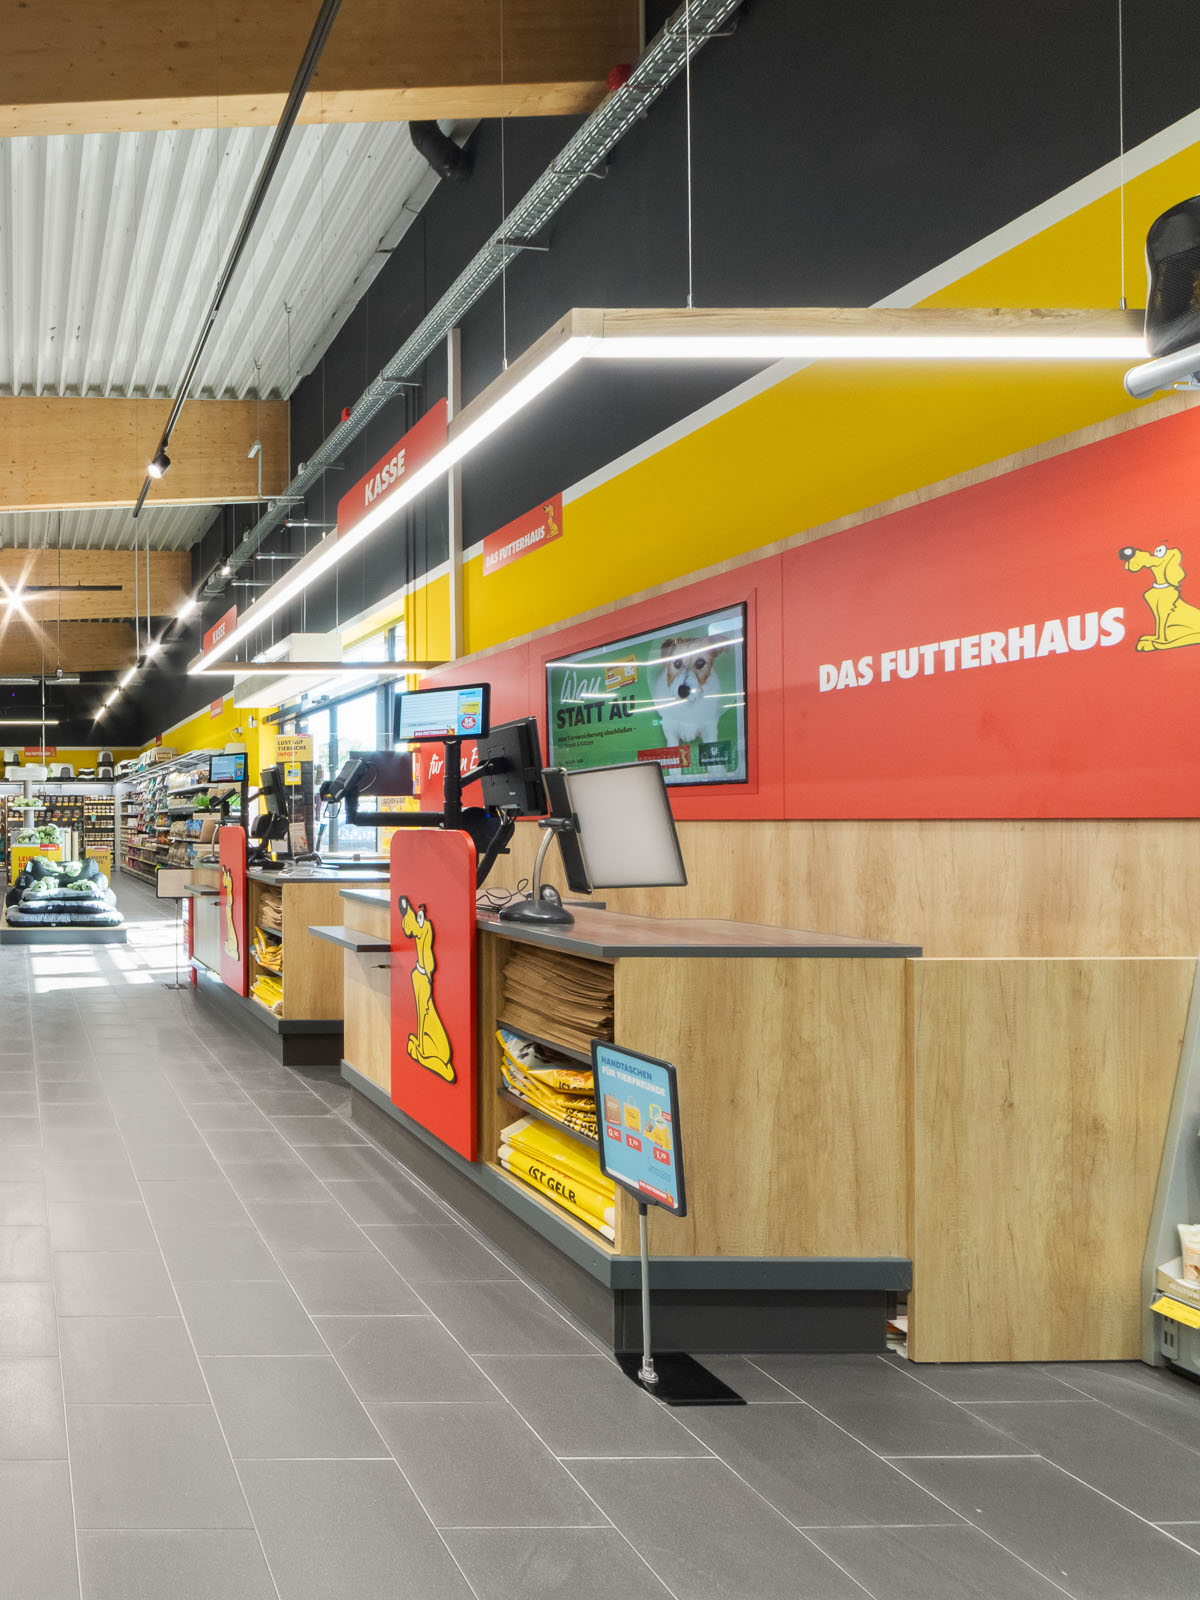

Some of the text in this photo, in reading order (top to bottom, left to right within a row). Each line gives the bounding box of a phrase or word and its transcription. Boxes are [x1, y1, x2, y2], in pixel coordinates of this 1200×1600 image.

[365, 448, 406, 506] KASSE
[485, 525, 546, 569] DAS FUTTERHAUS
[819, 607, 1126, 692] DAS FUTTERHAUS
[557, 701, 605, 729] STATT
[428, 753, 443, 780] für
[601, 1055, 652, 1081] HANDTASCHEN
[528, 1165, 547, 1184] IST
